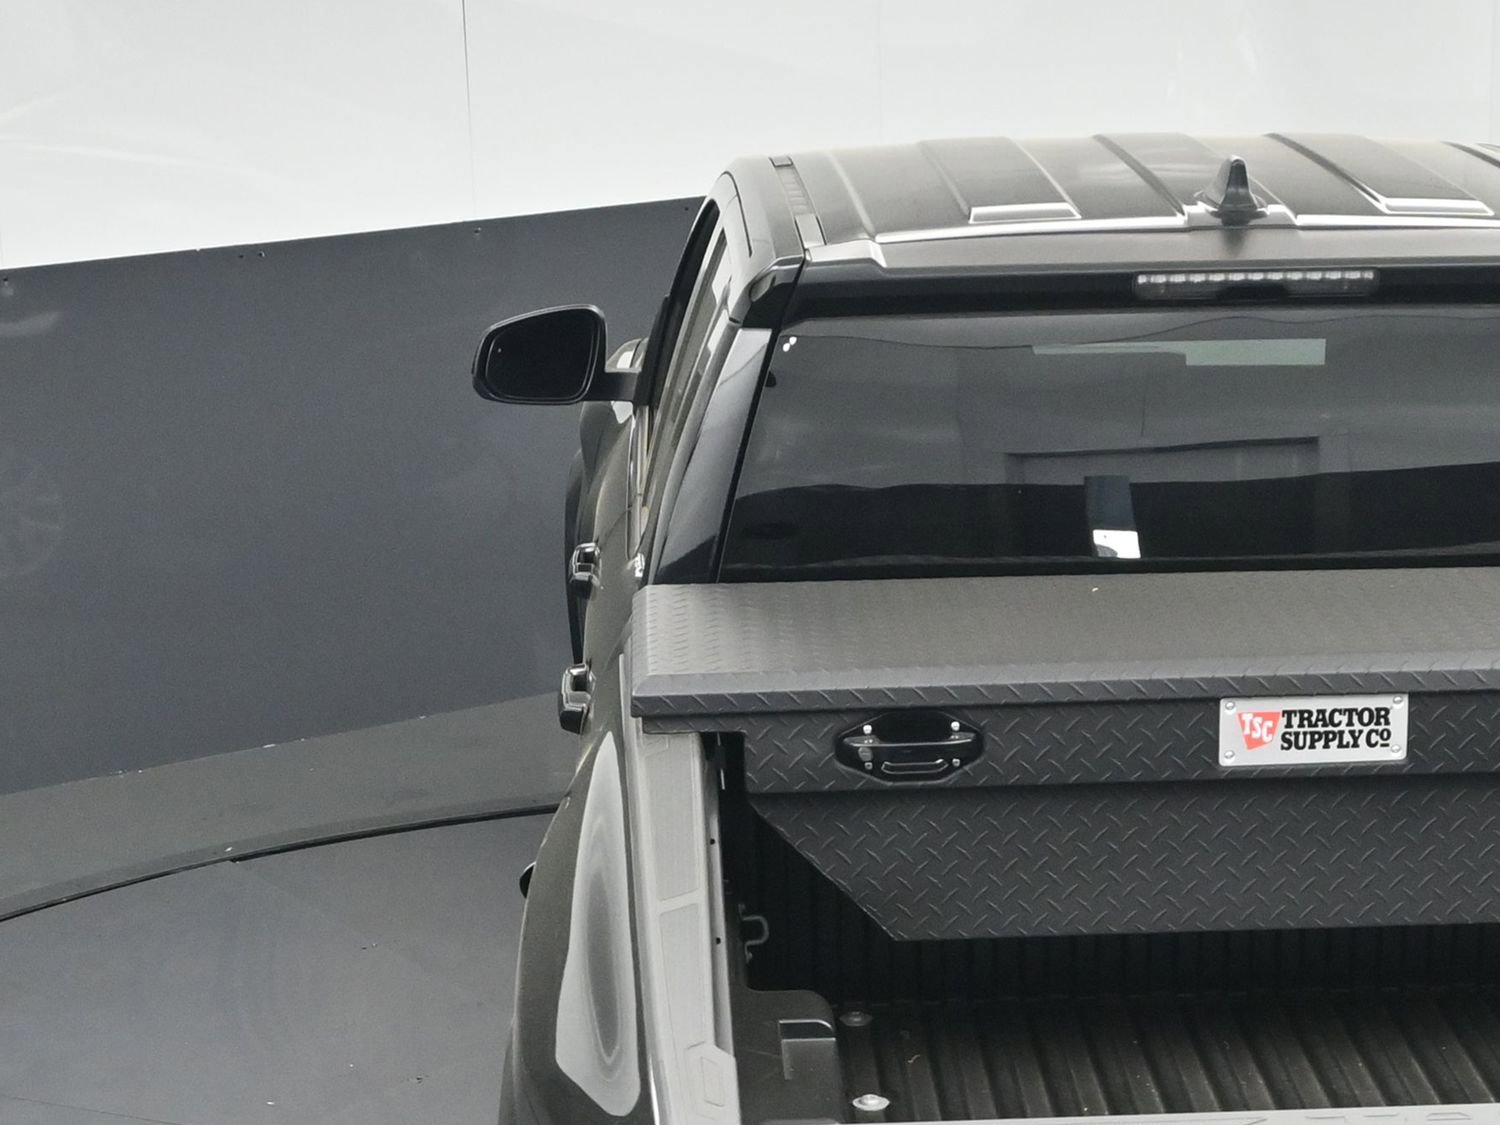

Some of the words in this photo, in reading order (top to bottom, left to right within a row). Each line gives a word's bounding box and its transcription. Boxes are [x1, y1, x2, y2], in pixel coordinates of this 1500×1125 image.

[1241, 712, 1273, 743] TSC
[1281, 707, 1391, 729] TRACTOR
[1280, 729, 1363, 751] SUPPLY
